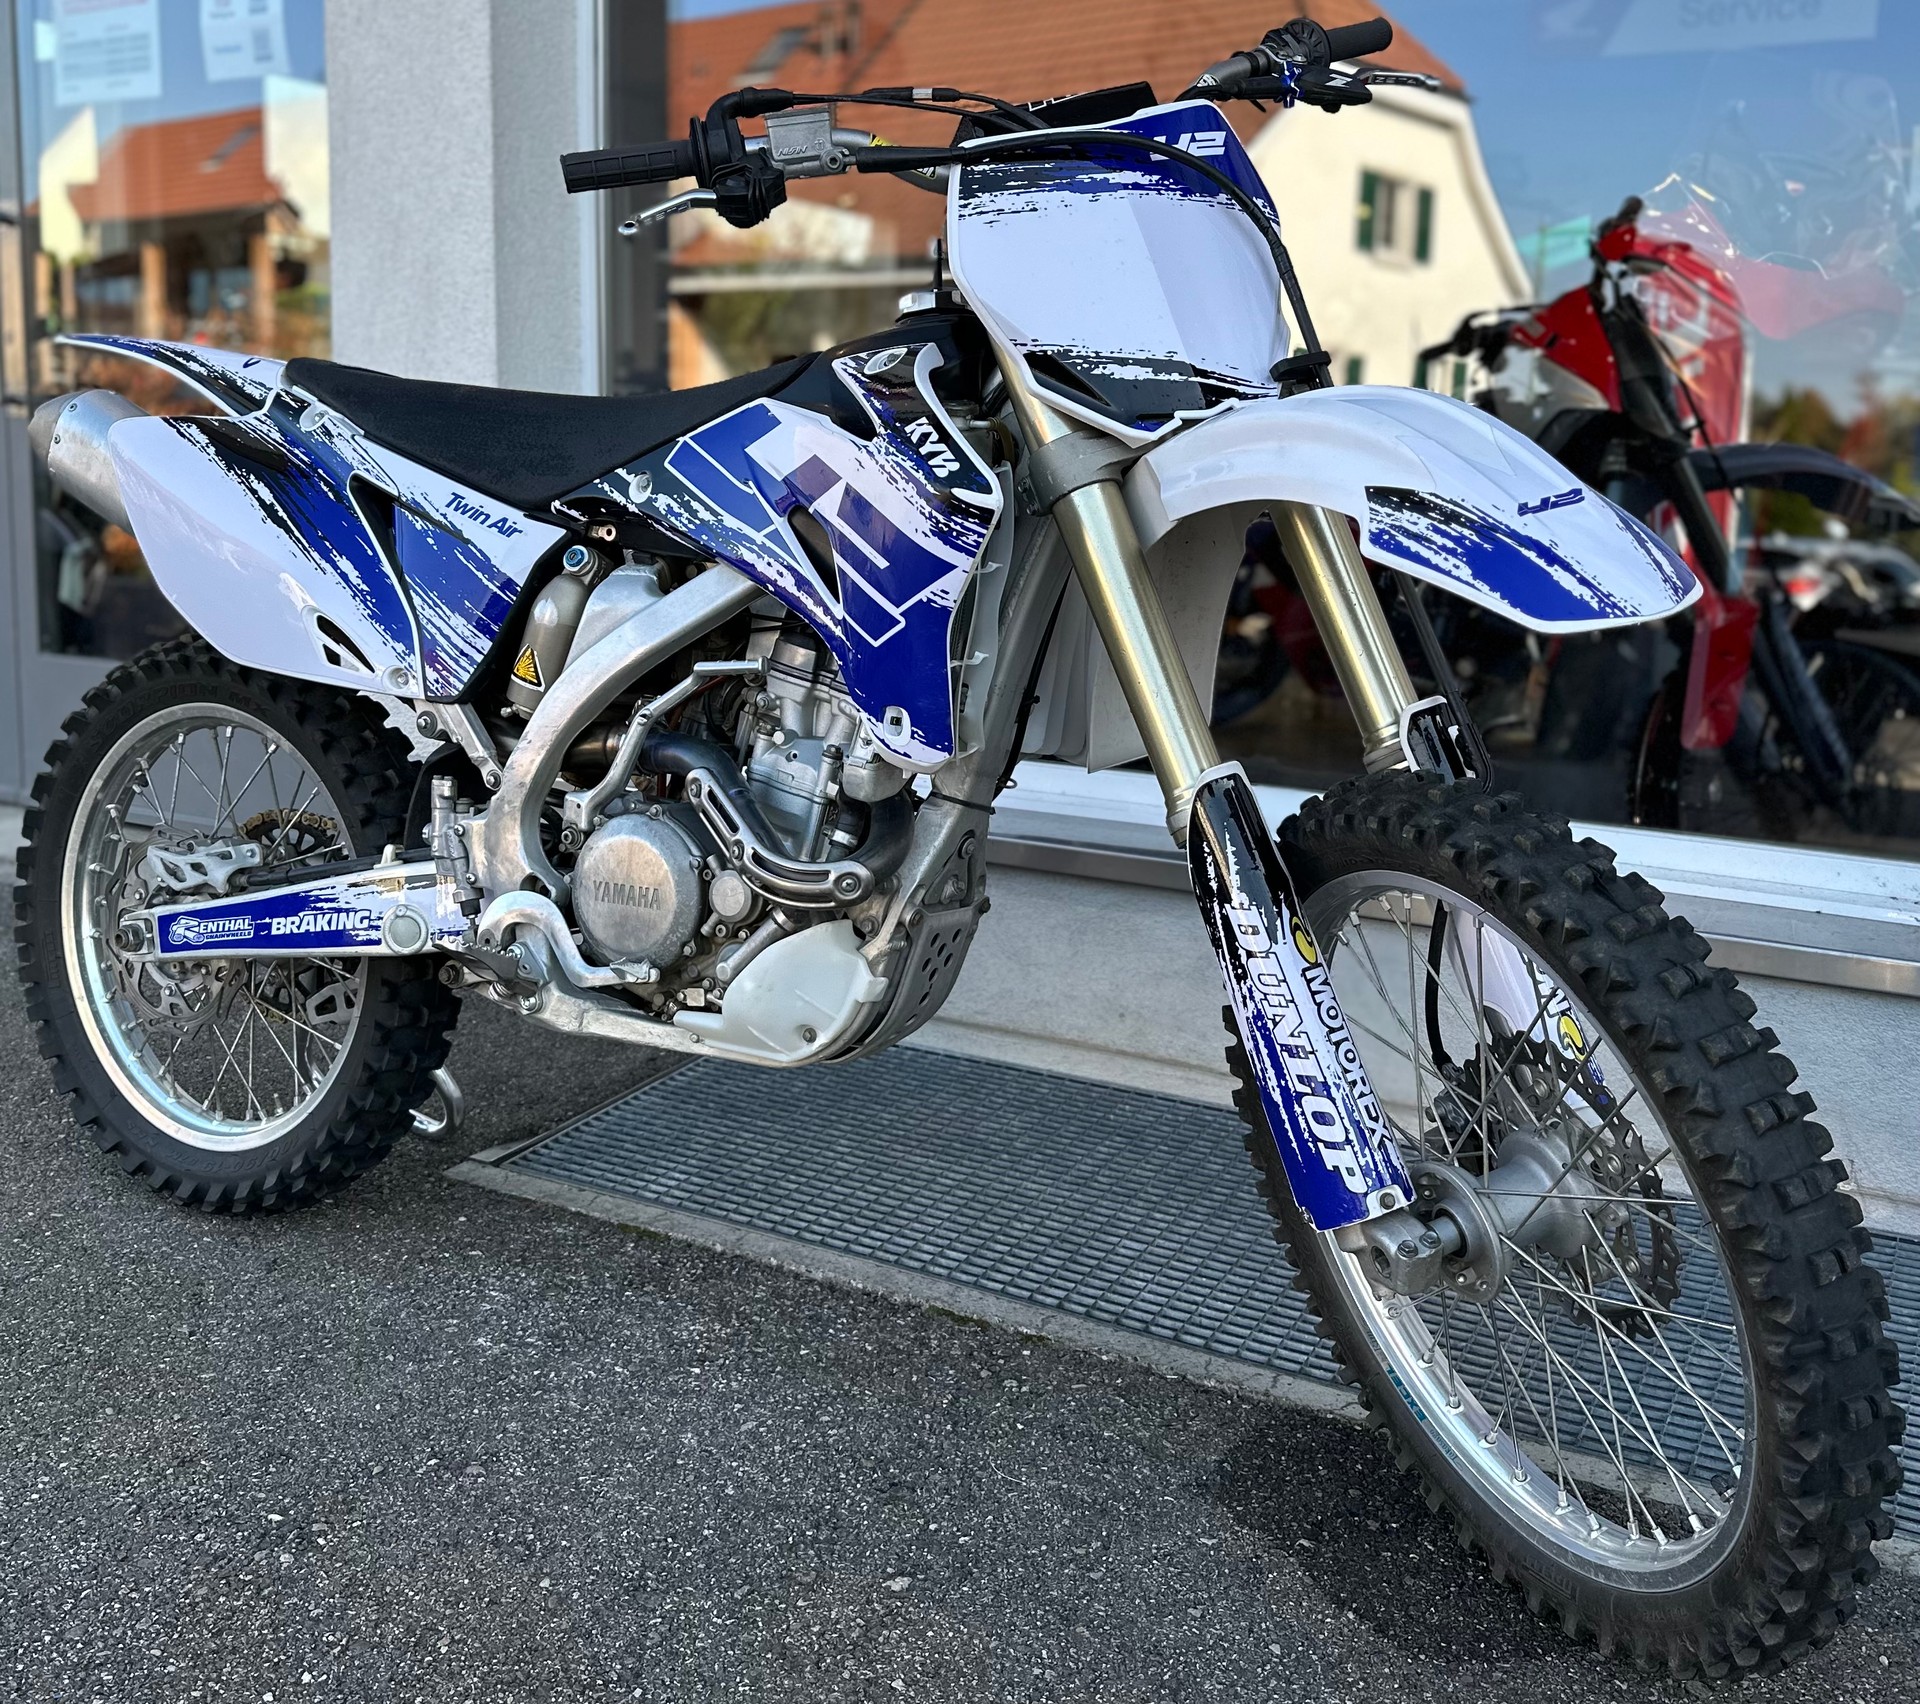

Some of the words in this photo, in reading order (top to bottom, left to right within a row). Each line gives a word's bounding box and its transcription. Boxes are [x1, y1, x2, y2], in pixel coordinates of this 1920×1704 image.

[904, 416, 960, 478] KYB
[445, 492, 491, 525] Twin
[486, 517, 524, 538] Air
[593, 880, 661, 911] YAMAHA
[171, 917, 253, 943] RENTHAL
[270, 909, 372, 936] BRAKING
[1224, 902, 1368, 1194] DUNLOP
[1301, 964, 1394, 1152] MOTOREX
[1386, 1363, 1428, 1422] EXCEL
